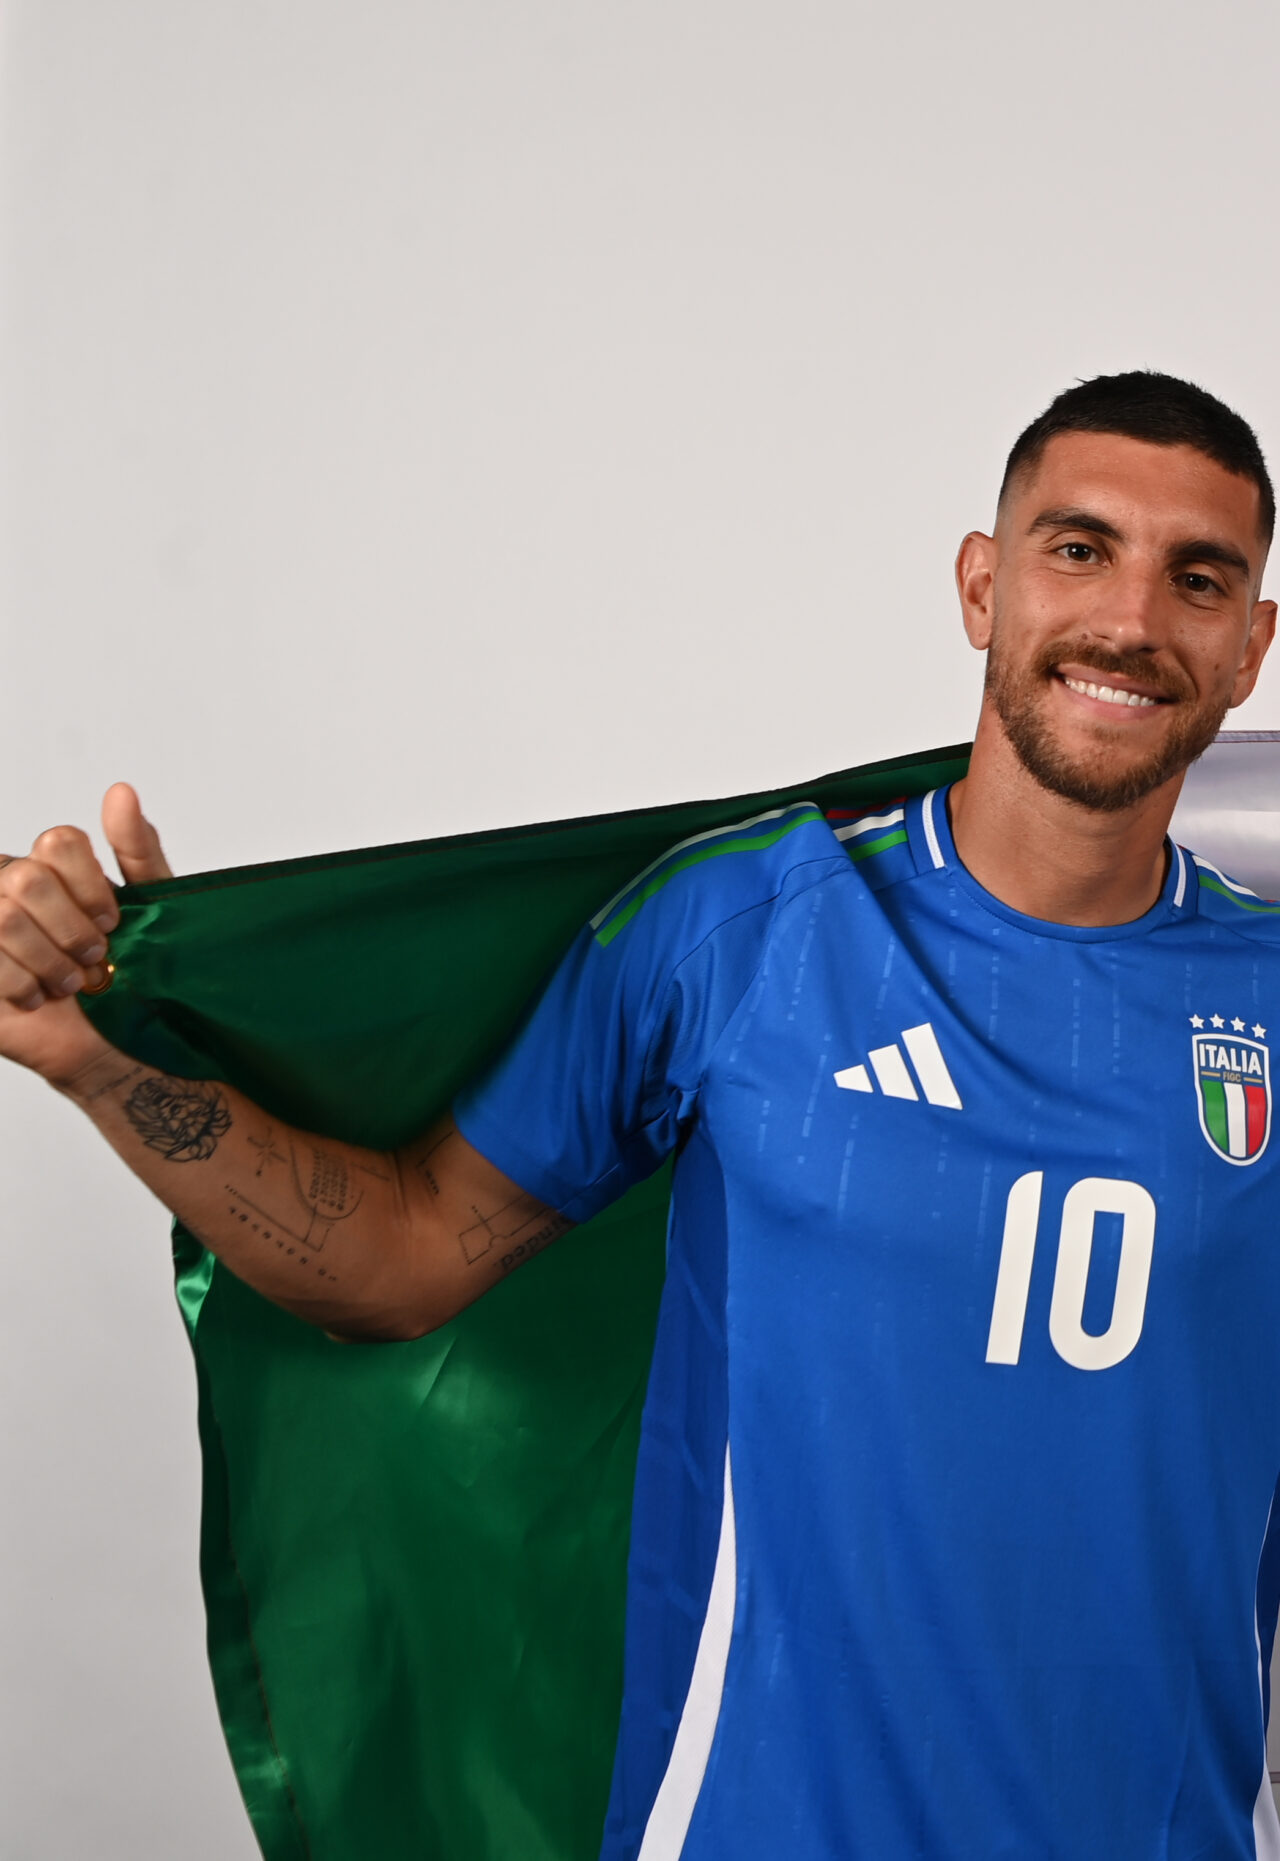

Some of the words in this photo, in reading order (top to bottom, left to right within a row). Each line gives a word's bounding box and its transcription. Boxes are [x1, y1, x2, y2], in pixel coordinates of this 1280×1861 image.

[1199, 1043, 1262, 1075] ITALIA
[1222, 1071, 1242, 1083] FIGC
[985, 1170, 1156, 1370] 10
